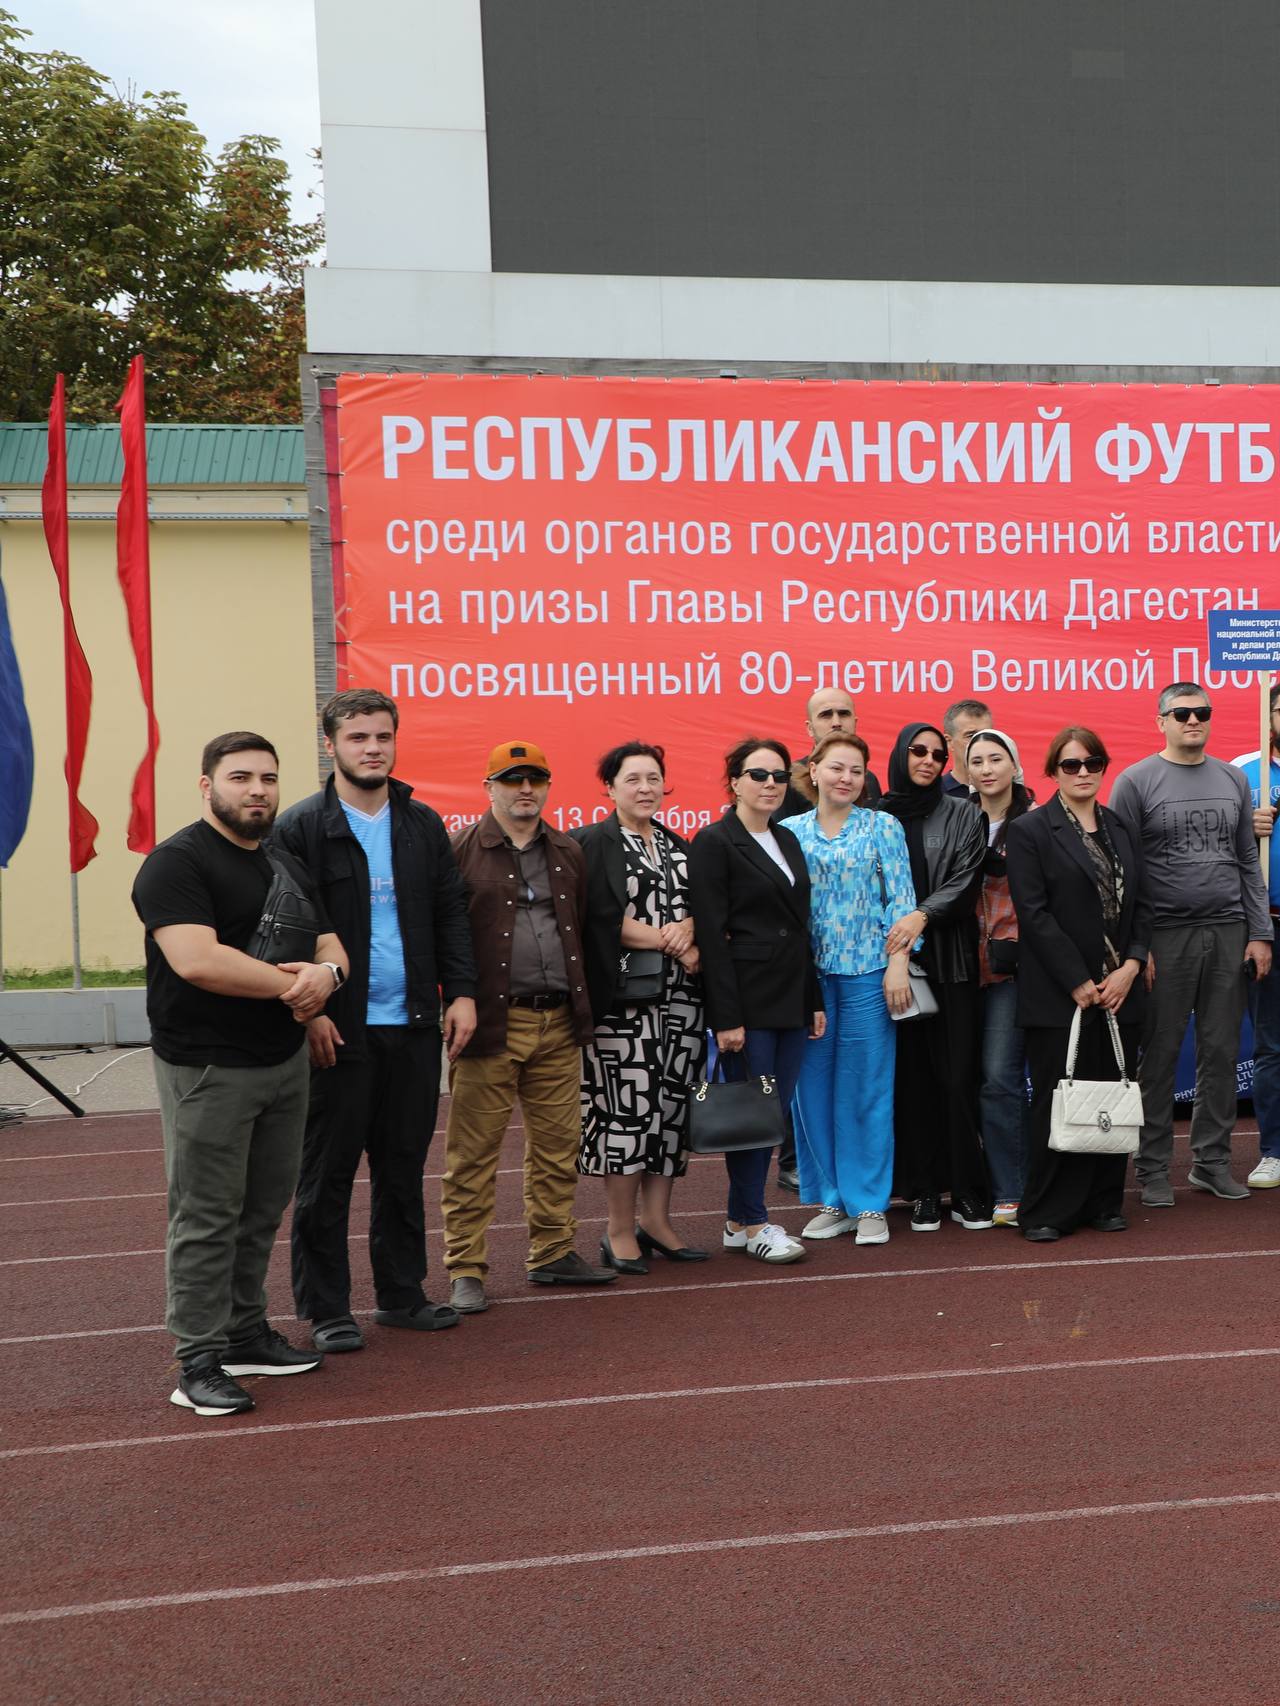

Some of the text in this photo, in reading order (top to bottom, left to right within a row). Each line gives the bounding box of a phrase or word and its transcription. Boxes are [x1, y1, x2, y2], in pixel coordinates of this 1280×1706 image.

[381, 406, 1072, 484] РЕСПУБЛИКАНСКИЙ
[386, 518, 526, 564] среди
[544, 519, 732, 564] органов
[750, 512, 1130, 565] государственной
[389, 578, 1259, 635] на призы Главы Республики Дагестан
[1216, 629, 1275, 639] национальной
[1231, 641, 1238, 649] и
[1239, 641, 1265, 650] делам
[390, 651, 721, 704] посвященный
[739, 650, 954, 695] 80-летию
[971, 648, 1155, 692] Великой
[1222, 651, 1271, 662] Республики
[553, 806, 583, 831] 13
